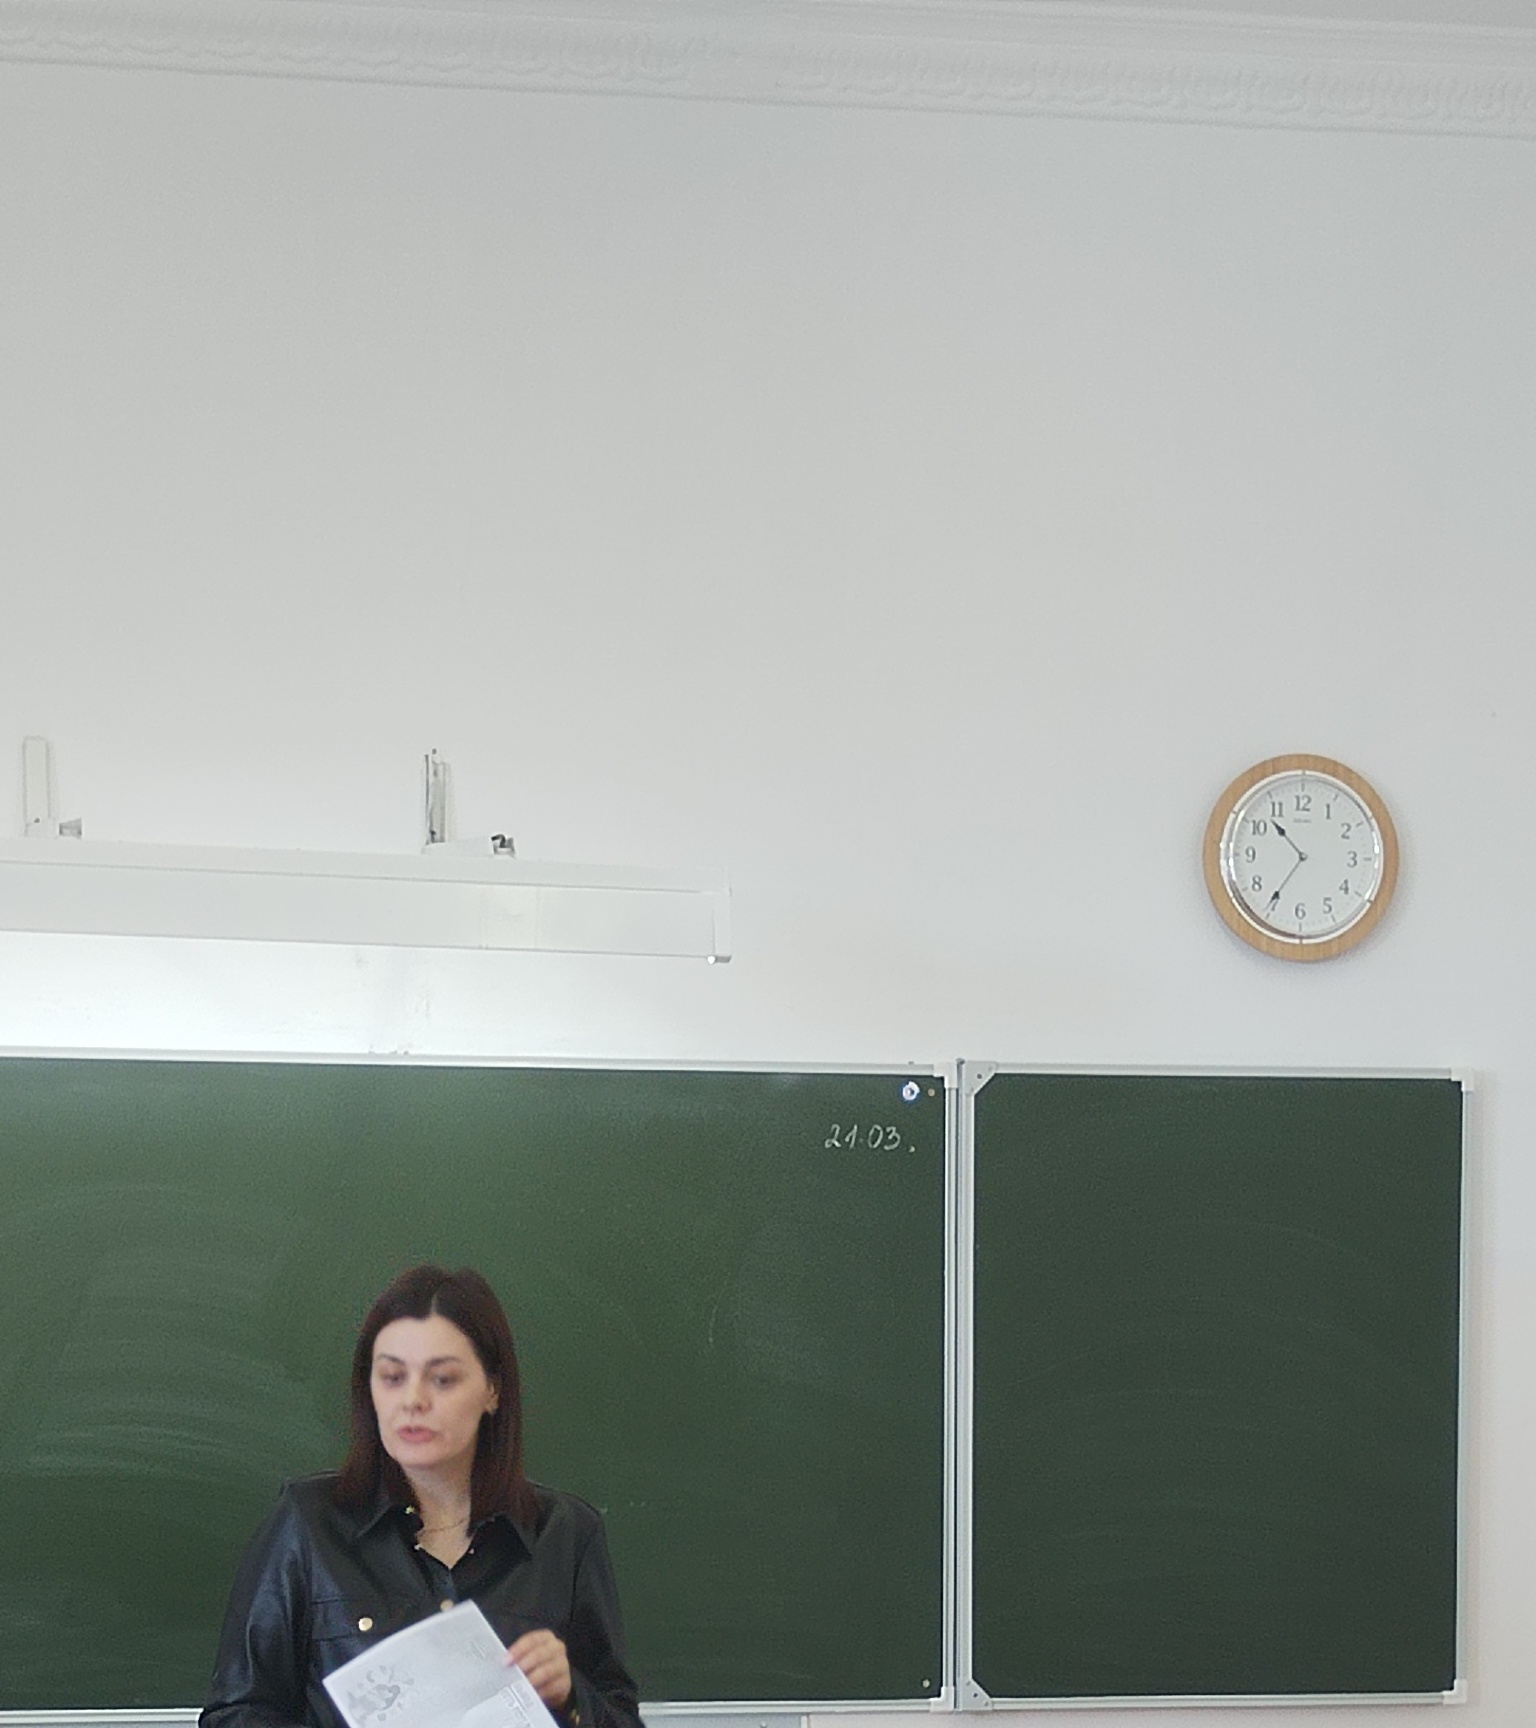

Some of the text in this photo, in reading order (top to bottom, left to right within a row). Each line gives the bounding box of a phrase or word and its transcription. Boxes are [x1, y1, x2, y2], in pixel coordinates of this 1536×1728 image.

[1270, 801, 1284, 818] 11
[1294, 795, 1312, 812] 12
[1324, 803, 1332, 820] 1
[1251, 819, 1268, 836] 10
[1341, 823, 1352, 839] 2
[1245, 846, 1256, 863] 9
[1347, 851, 1358, 867] 3
[1251, 875, 1262, 892] 8
[1339, 879, 1349, 895] 4
[1295, 903, 1306, 919] 6
[1322, 897, 1333, 914] 5
